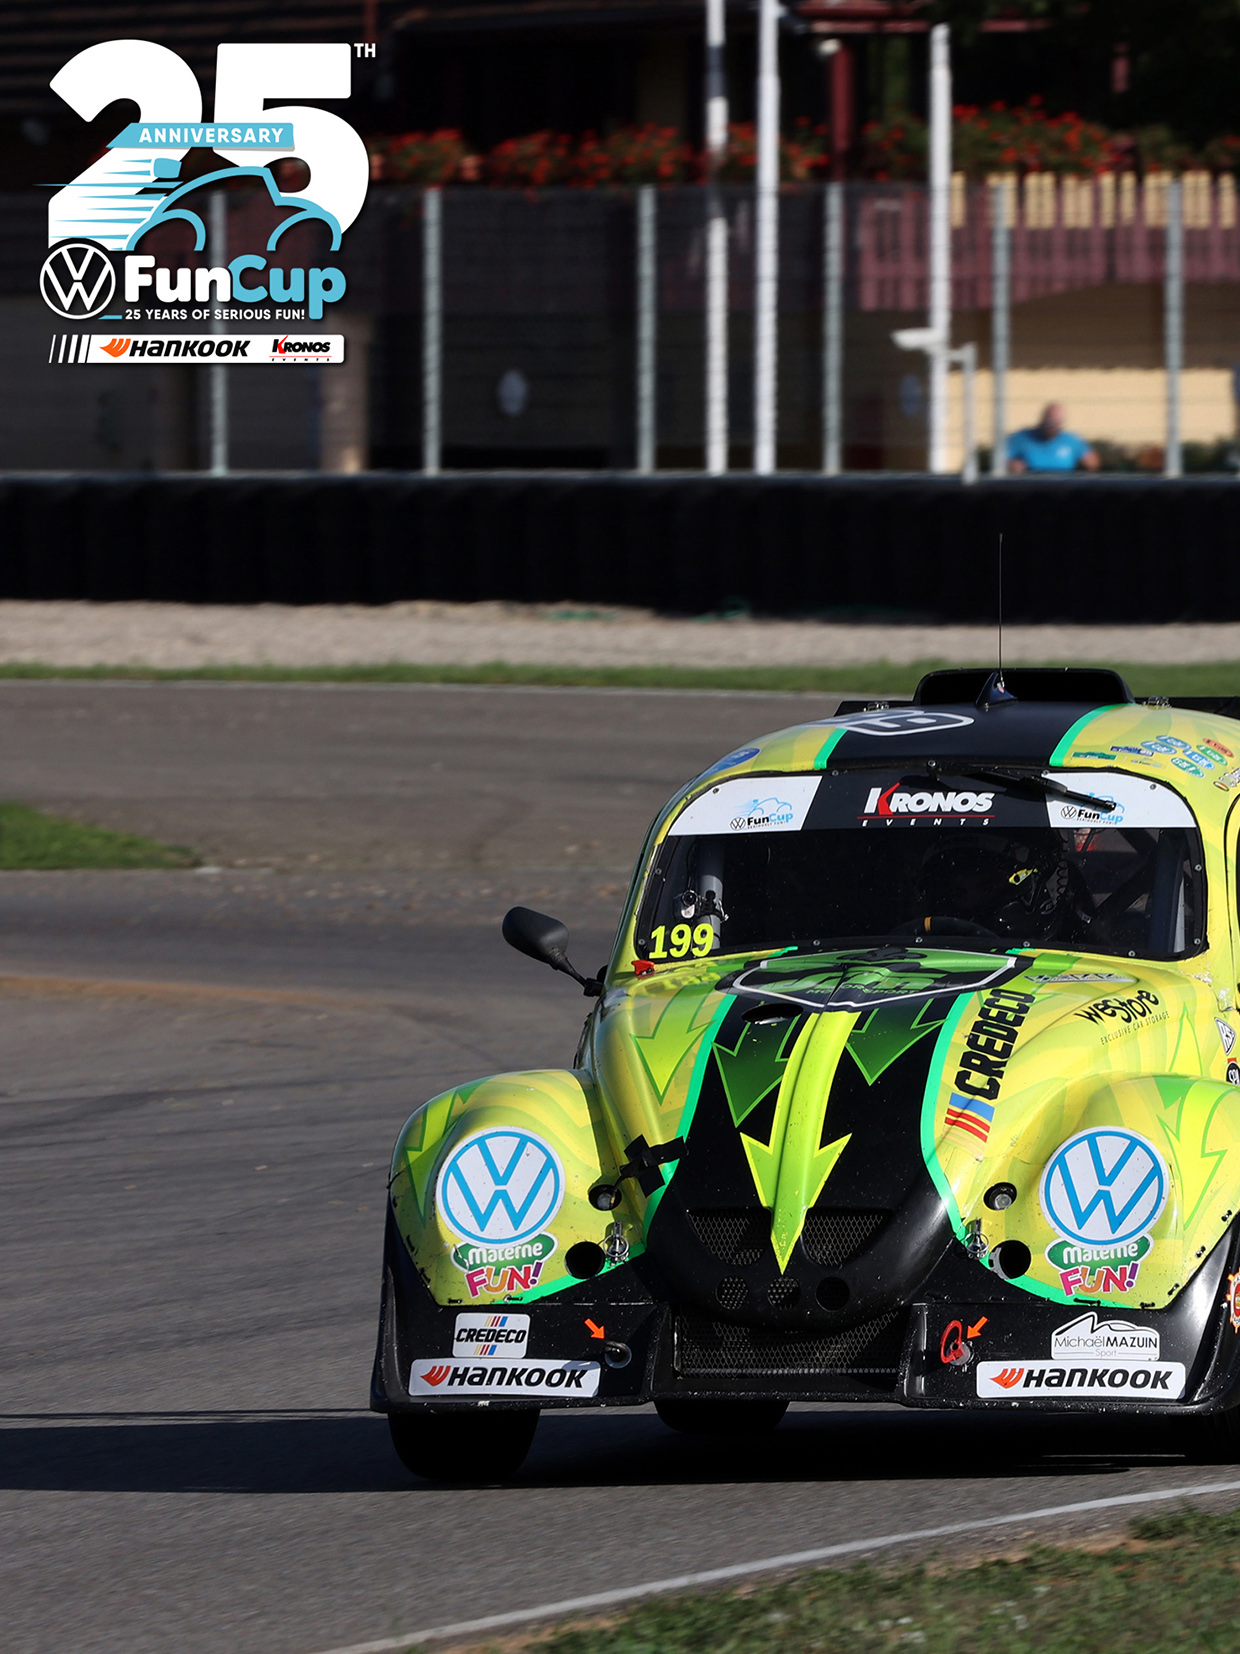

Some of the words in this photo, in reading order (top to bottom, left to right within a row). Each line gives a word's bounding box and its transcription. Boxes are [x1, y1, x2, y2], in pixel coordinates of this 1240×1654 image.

[864, 781, 995, 815] KRONOS
[747, 813, 793, 826] FunCup
[862, 818, 989, 827] EVENTS
[1077, 809, 1124, 825] FunCup
[649, 923, 714, 959] 199
[955, 989, 1036, 1100] CREDECO
[1100, 1025, 1131, 1045] EXCLUSIVE
[1133, 1021, 1144, 1031] CAR
[1146, 1011, 1170, 1026] STORAGE
[465, 1261, 543, 1297] FUN!
[1060, 1262, 1139, 1296] FUN!
[456, 1329, 527, 1343] CREDECO
